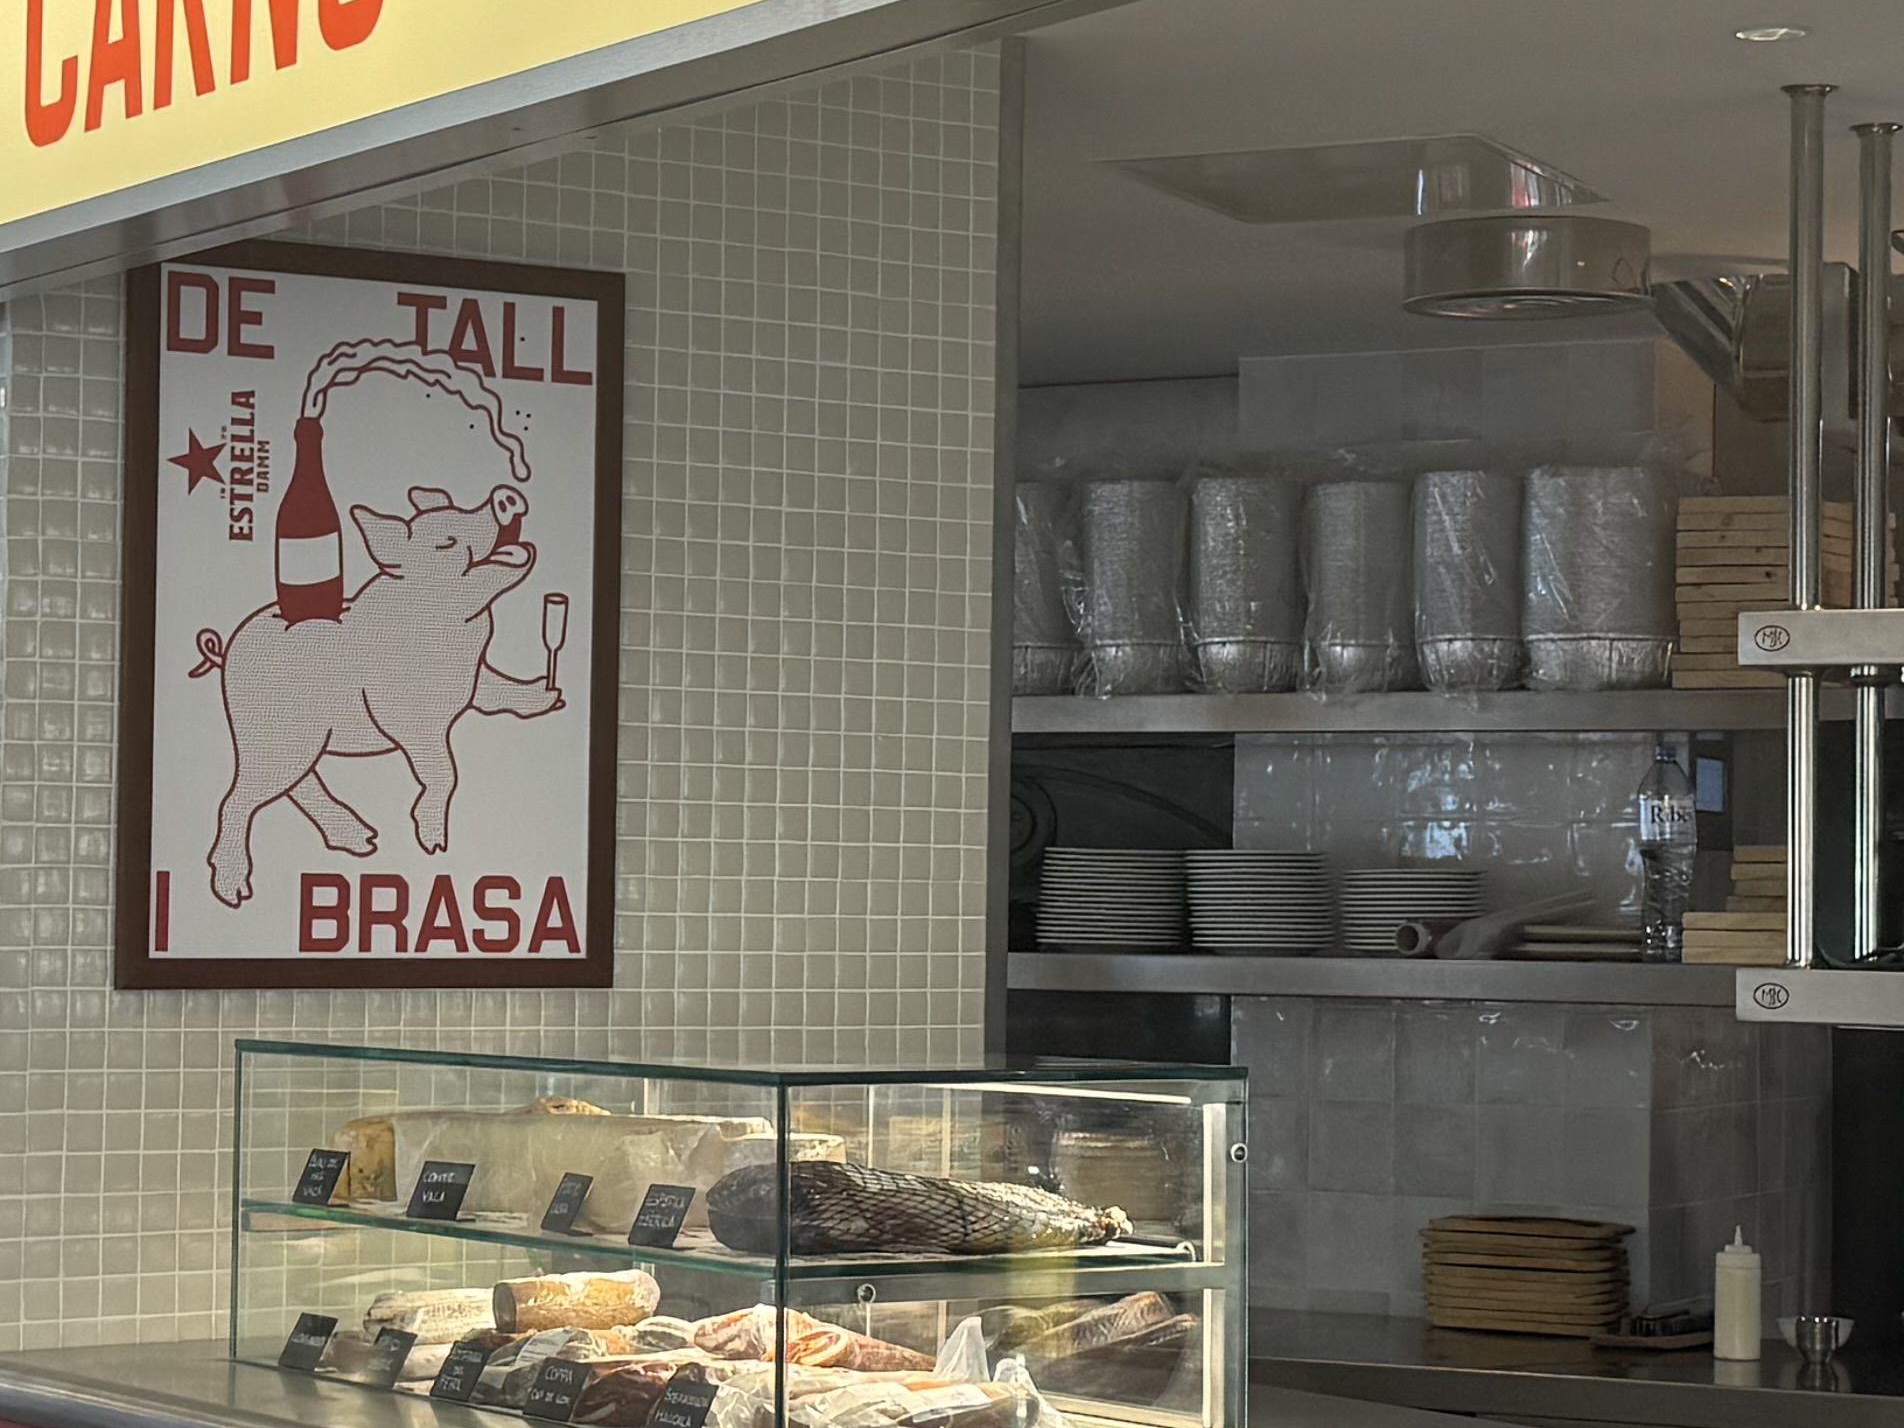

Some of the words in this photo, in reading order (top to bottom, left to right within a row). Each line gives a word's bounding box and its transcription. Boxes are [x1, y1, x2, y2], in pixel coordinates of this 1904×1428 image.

[166, 269, 276, 360] DE
[397, 291, 593, 386] TALL
[229, 389, 256, 543] ESTRELLA
[256, 439, 270, 493] DAMM
[155, 871, 171, 952] I
[299, 873, 581, 954] BRASA
